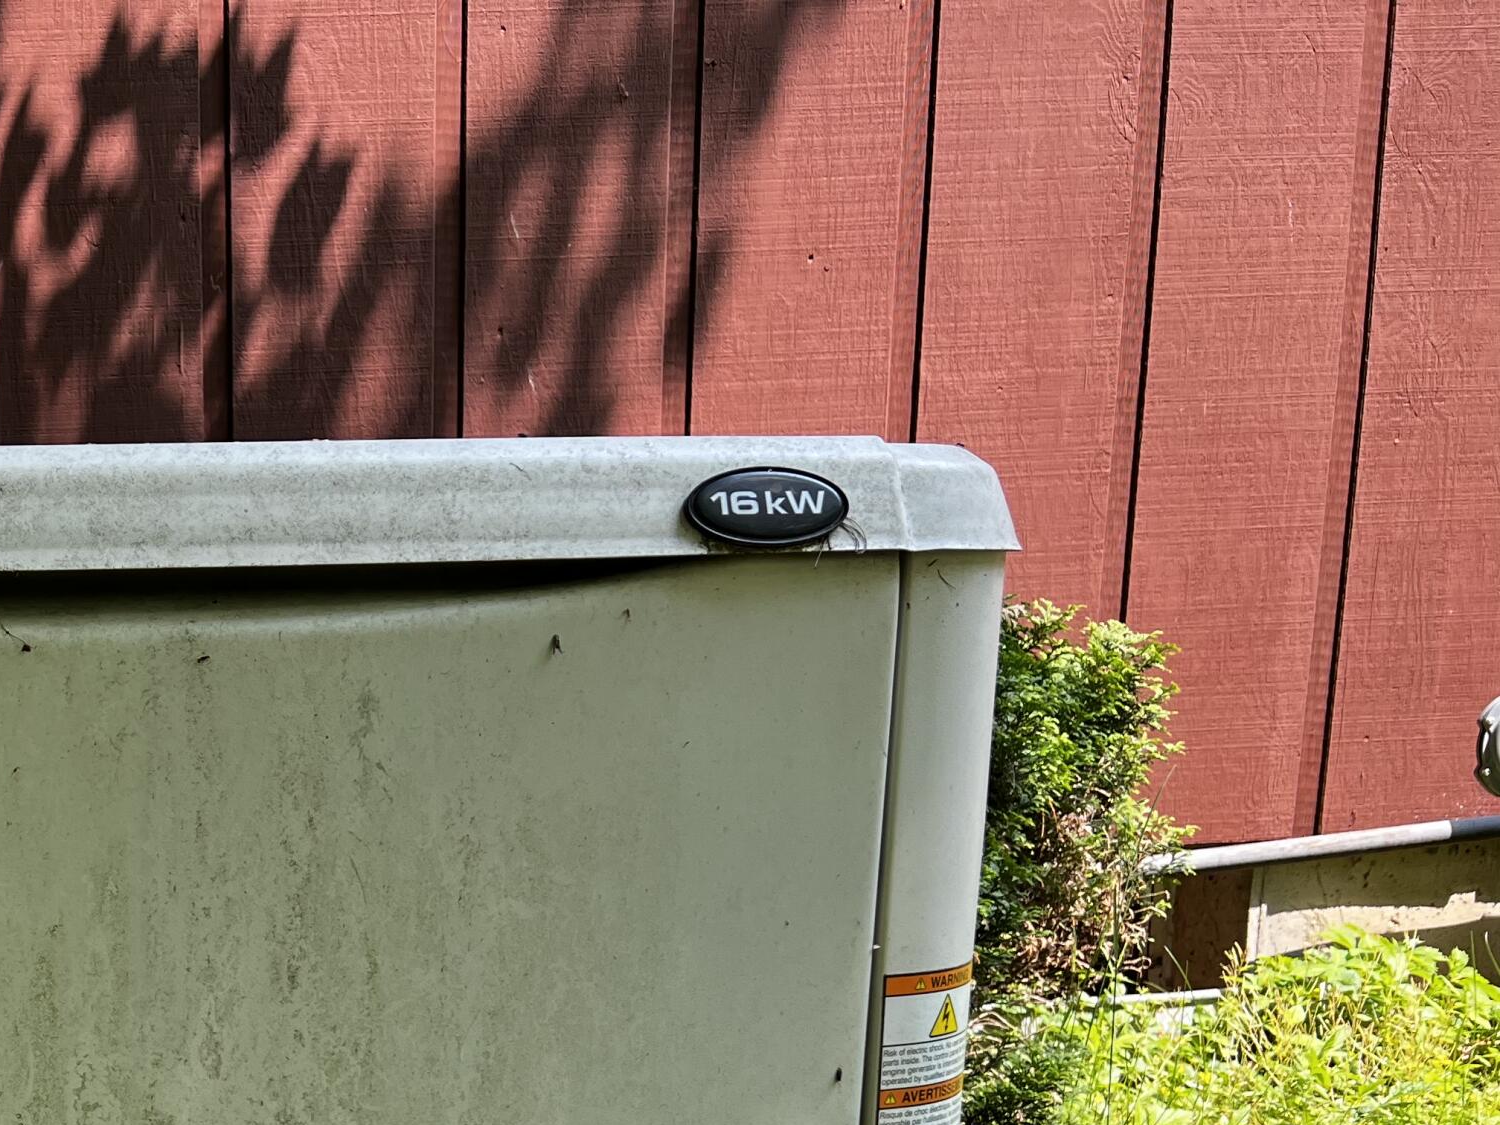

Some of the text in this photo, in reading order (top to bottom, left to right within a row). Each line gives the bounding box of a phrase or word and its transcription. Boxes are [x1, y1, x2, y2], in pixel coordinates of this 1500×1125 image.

[710, 490, 825, 515] 16 kW
[883, 1069, 905, 1077] engine
